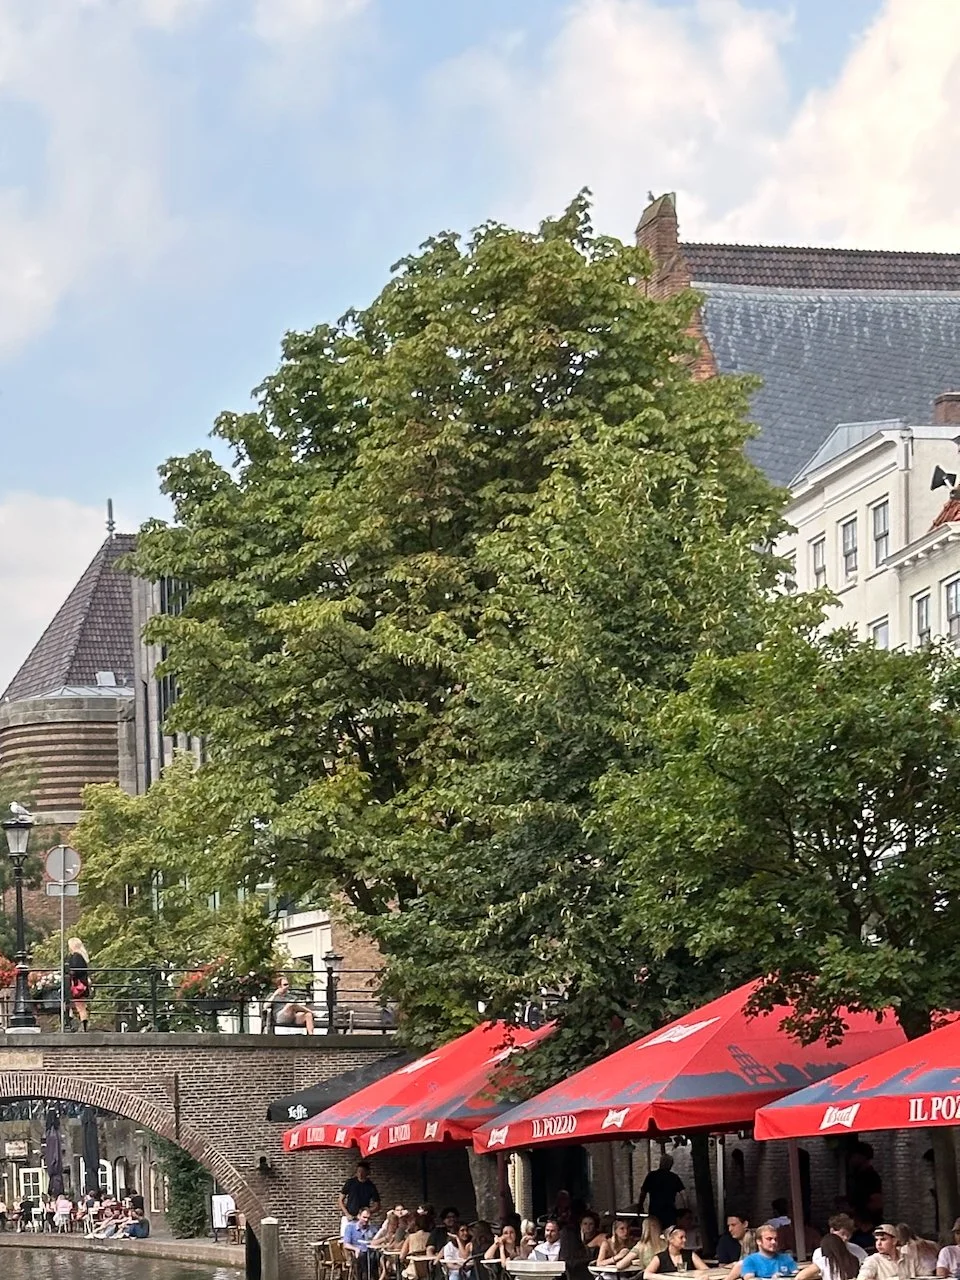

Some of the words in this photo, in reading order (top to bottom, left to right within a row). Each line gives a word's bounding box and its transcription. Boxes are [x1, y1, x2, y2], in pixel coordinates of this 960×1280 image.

[826, 1106, 853, 1124] Bud
[908, 1098, 928, 1121] IL
[532, 1119, 543, 1138] IL
[544, 1115, 577, 1137] POZZO
